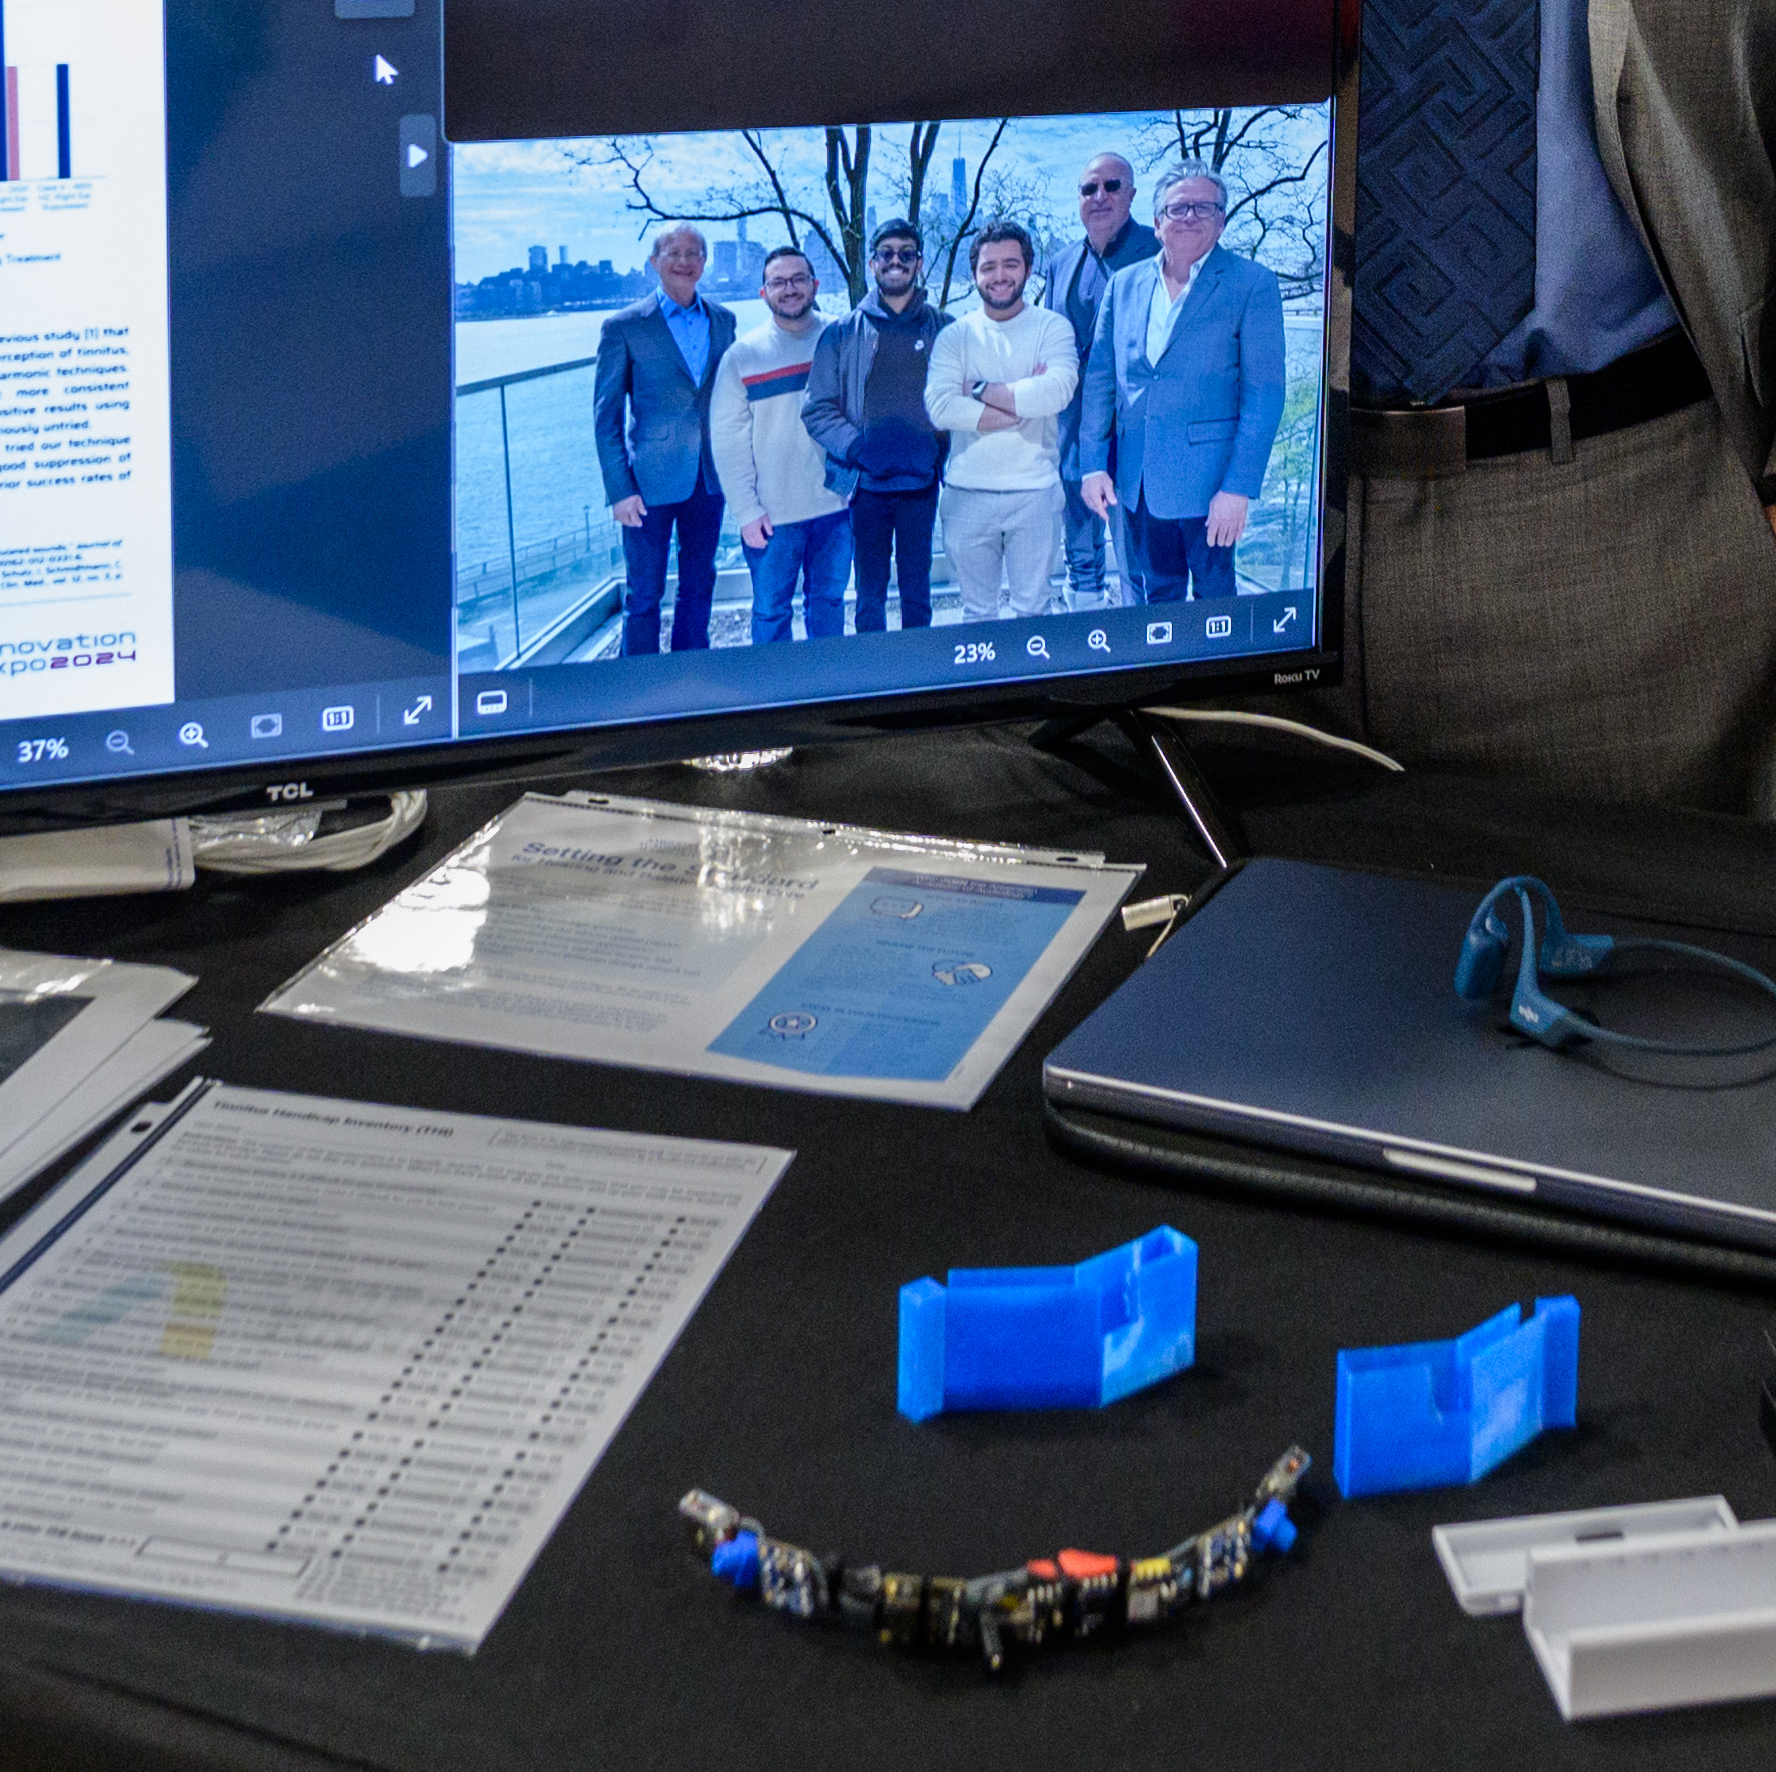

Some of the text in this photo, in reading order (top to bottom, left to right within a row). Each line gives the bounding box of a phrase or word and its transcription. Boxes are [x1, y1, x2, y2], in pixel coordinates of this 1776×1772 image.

[954, 641, 996, 665] 23%
[1301, 669, 1321, 683] TV
[18, 736, 70, 763] 37%
[267, 780, 314, 801] TCL
[521, 840, 678, 872] Setting the
